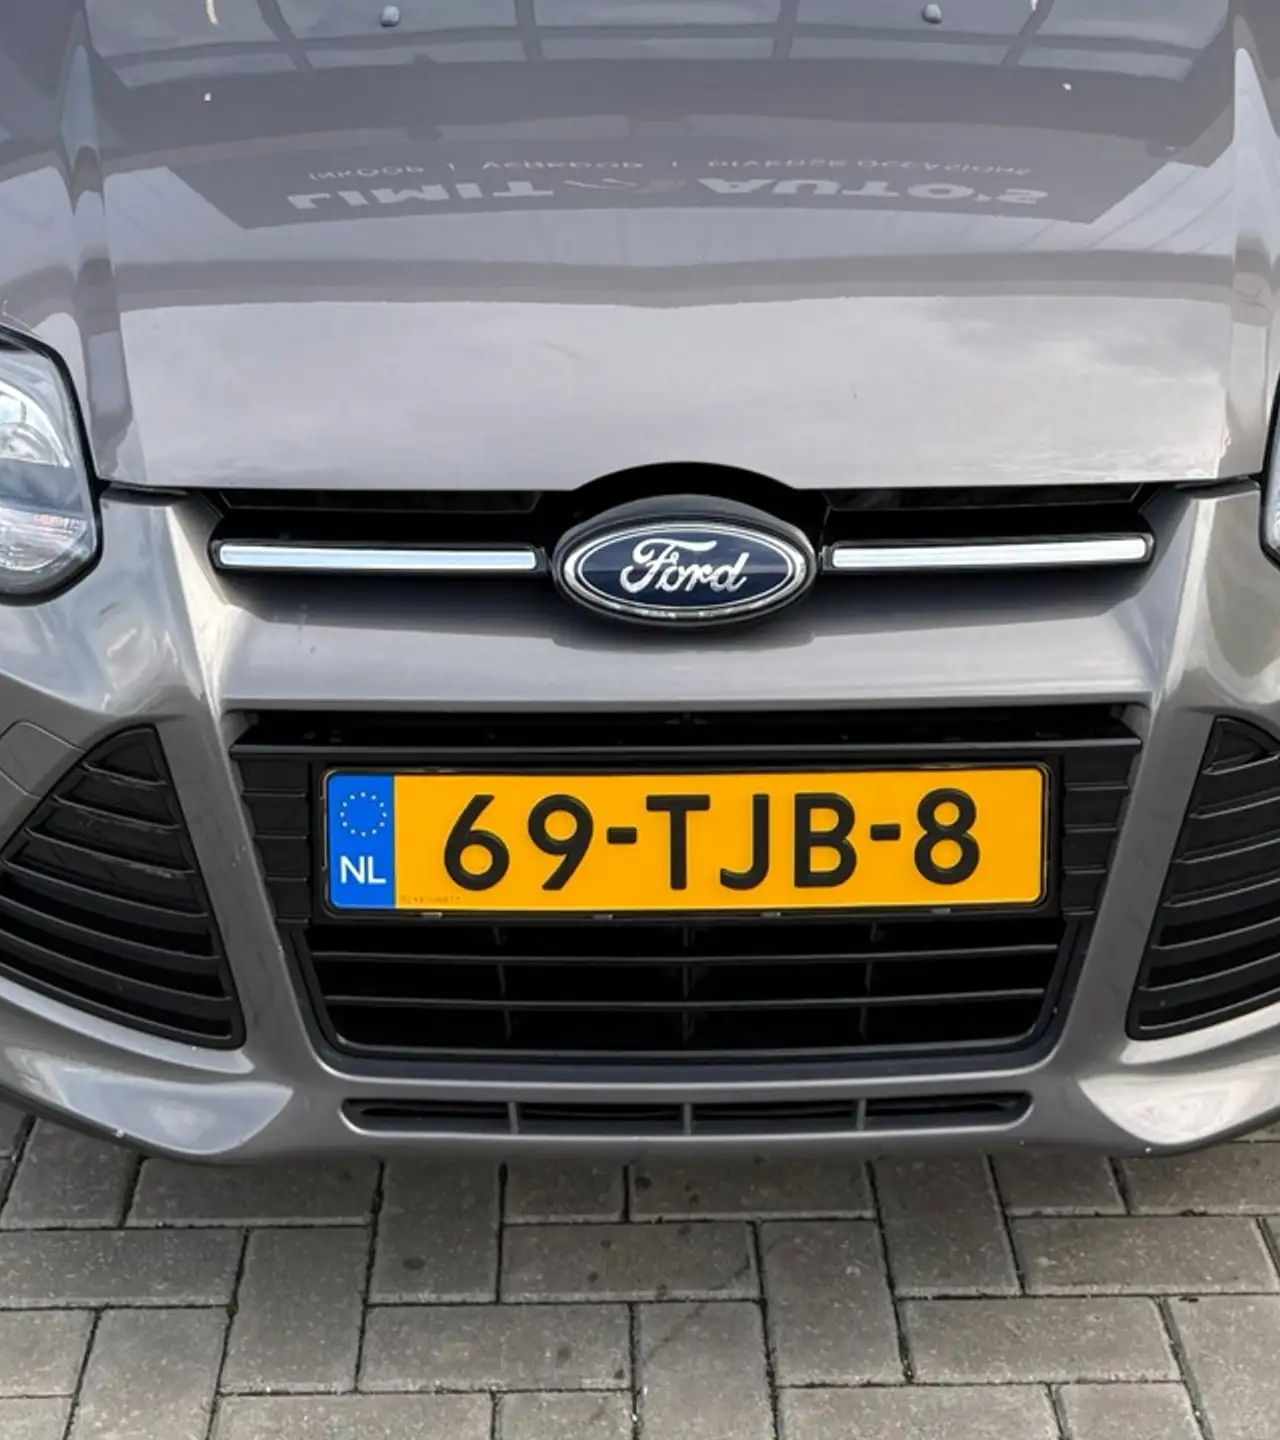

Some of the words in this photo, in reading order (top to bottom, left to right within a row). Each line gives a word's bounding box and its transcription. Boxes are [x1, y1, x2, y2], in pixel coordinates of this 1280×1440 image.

[620, 538, 750, 594] Ford
[443, 787, 981, 892] 69-TJB-8
[339, 855, 387, 885] NL
